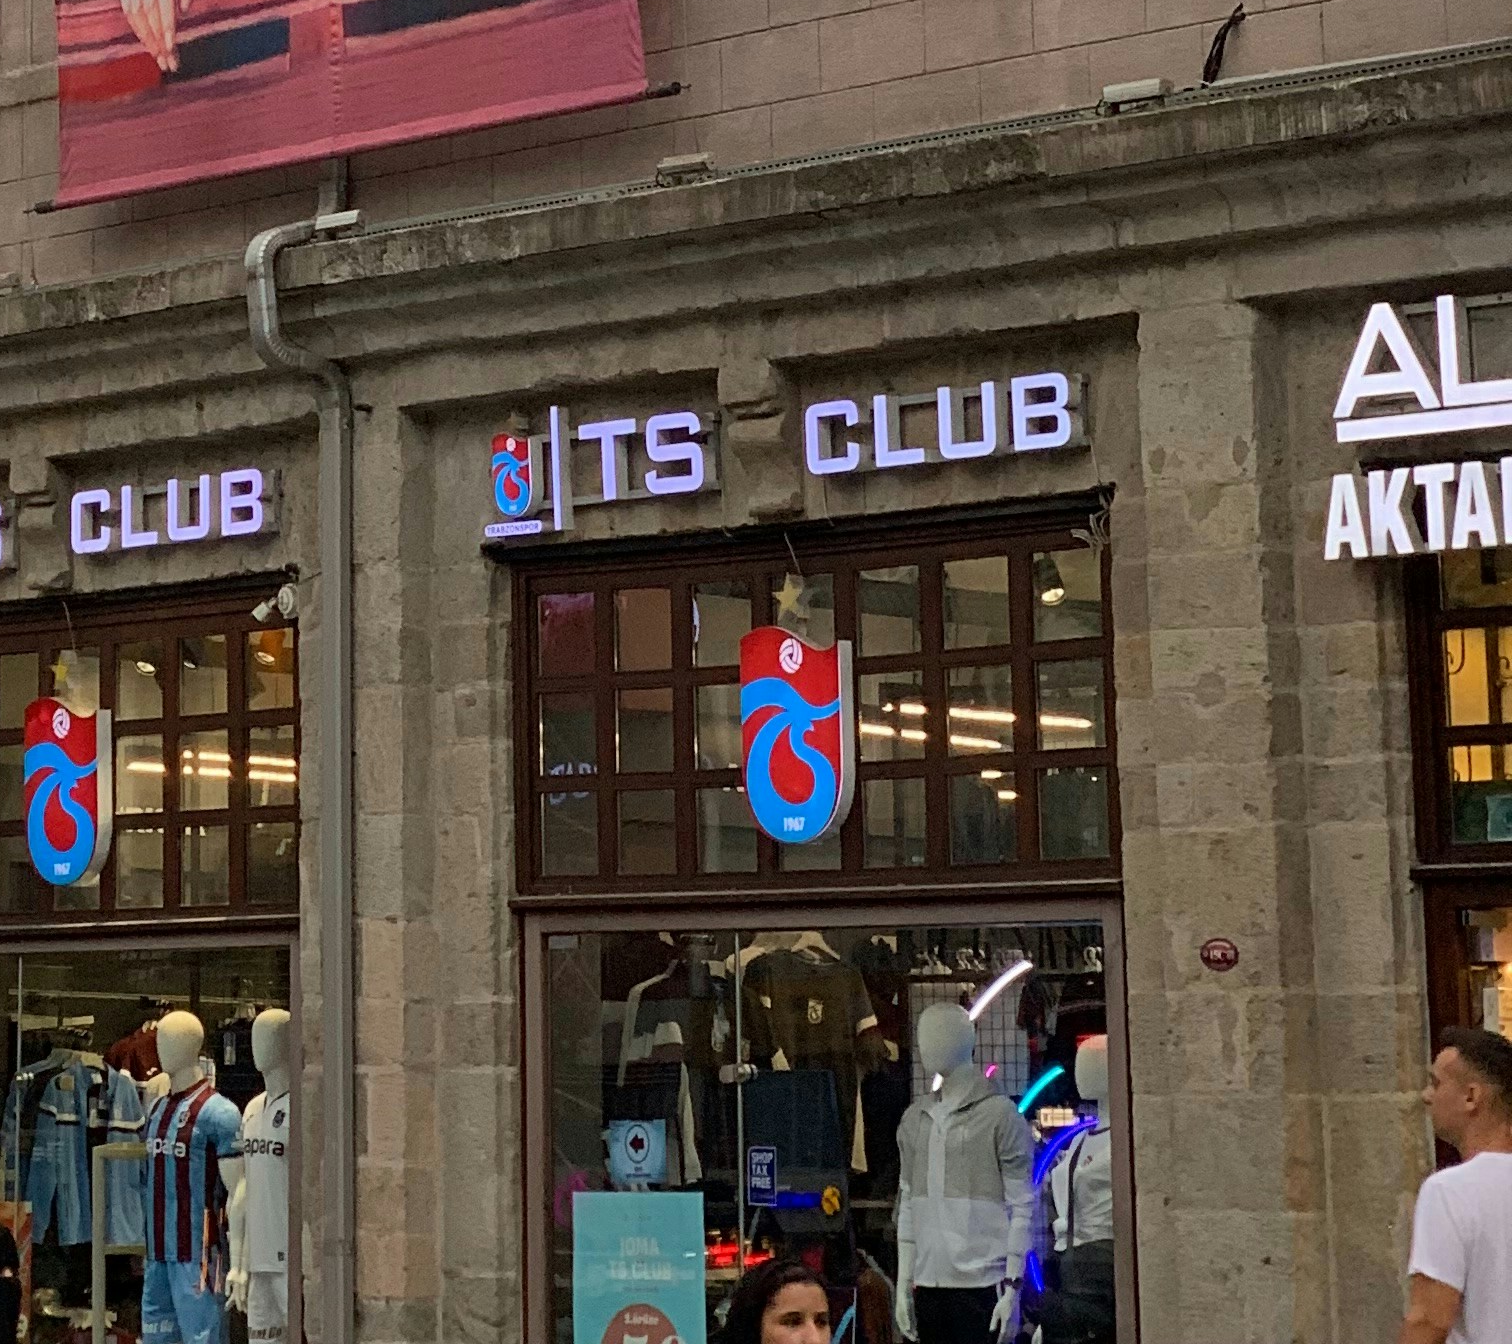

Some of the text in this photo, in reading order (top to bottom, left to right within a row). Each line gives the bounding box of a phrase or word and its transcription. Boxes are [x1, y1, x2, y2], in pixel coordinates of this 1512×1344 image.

[579, 372, 1071, 501] TS CLUB
[71, 468, 263, 554] CLUB
[487, 522, 539, 535] TRABZONSPOR
[751, 1152, 773, 1163] SHOP
[752, 1164, 768, 1176] TAX
[751, 1177, 771, 1189] FREE
